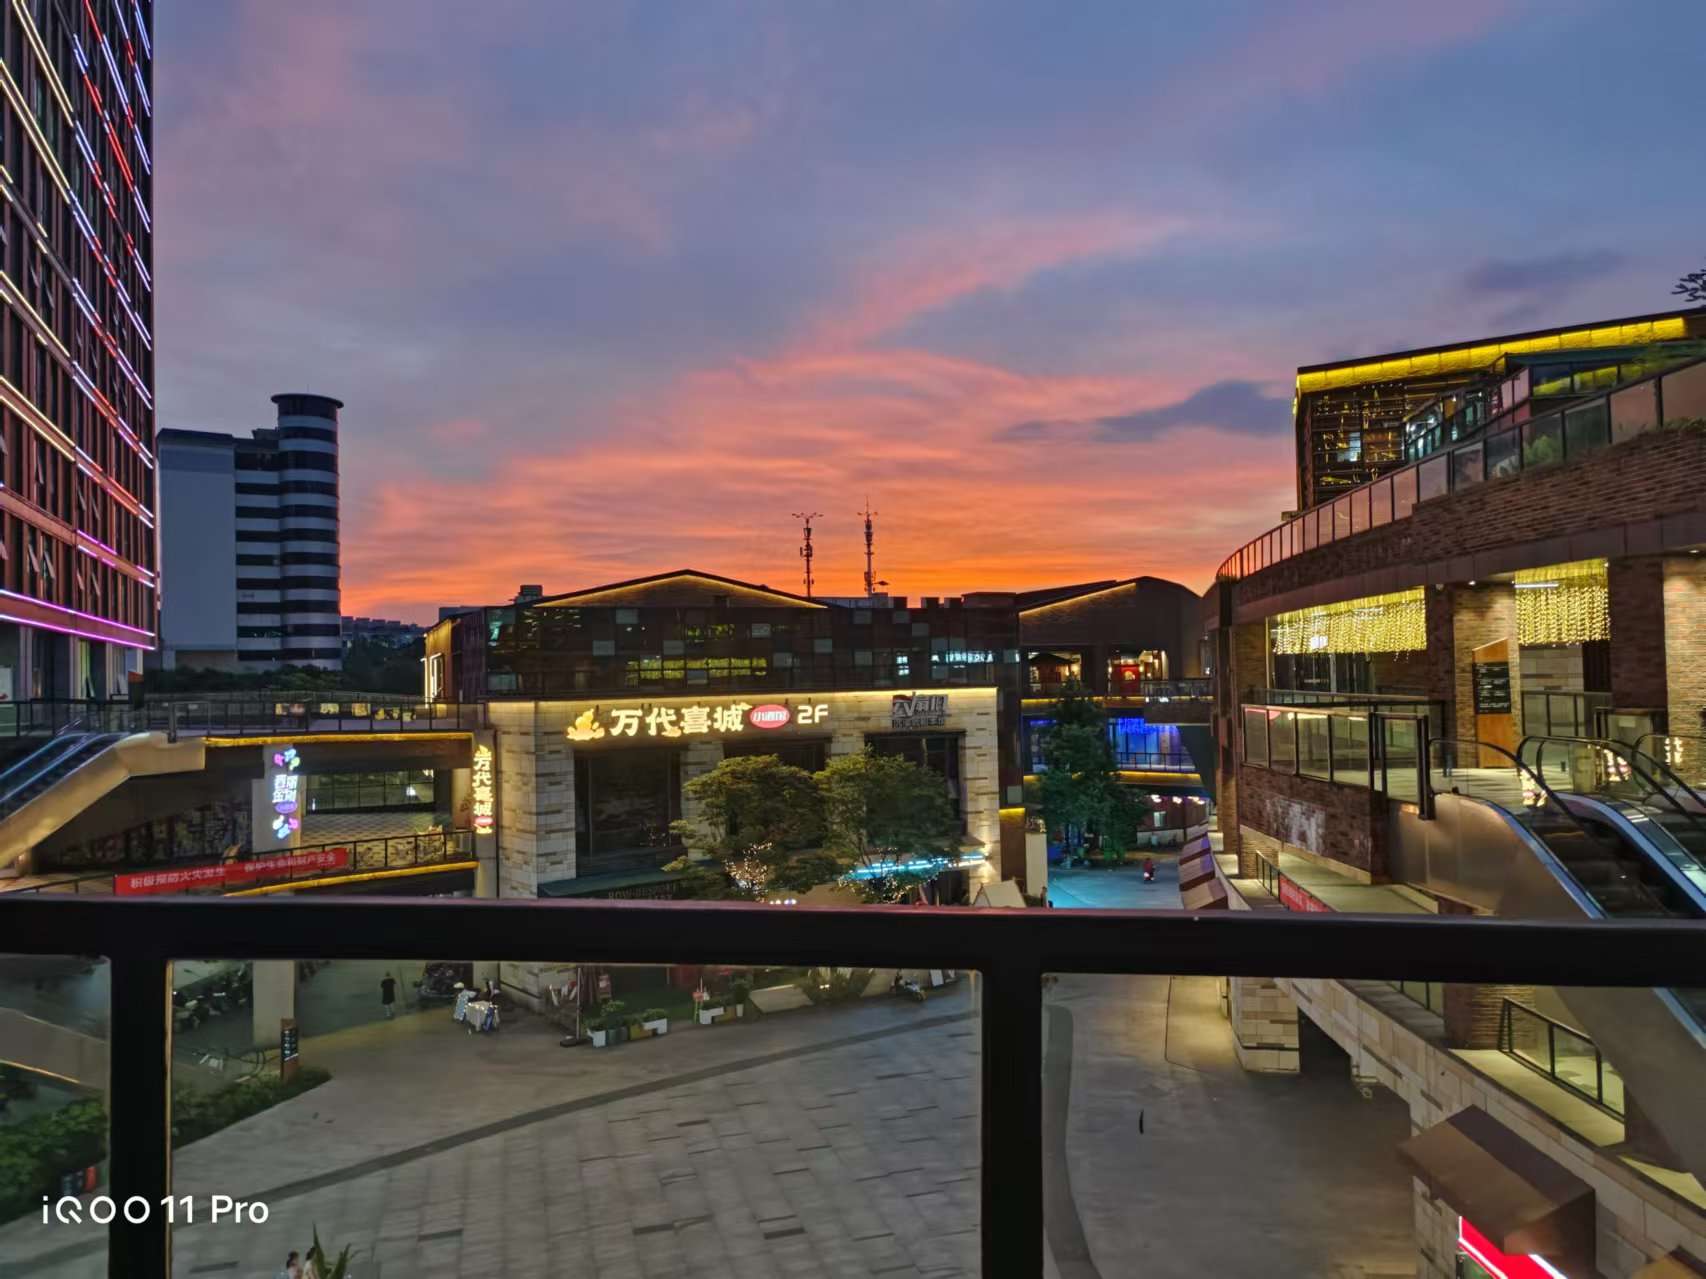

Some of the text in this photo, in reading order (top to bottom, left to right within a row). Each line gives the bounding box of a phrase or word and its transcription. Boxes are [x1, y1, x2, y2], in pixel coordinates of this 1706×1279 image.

[609, 705, 745, 737] 万代喜城
[797, 704, 829, 724] 2F
[471, 754, 493, 816] 万代喜城
[130, 867, 225, 888] 积极预防火灾发生
